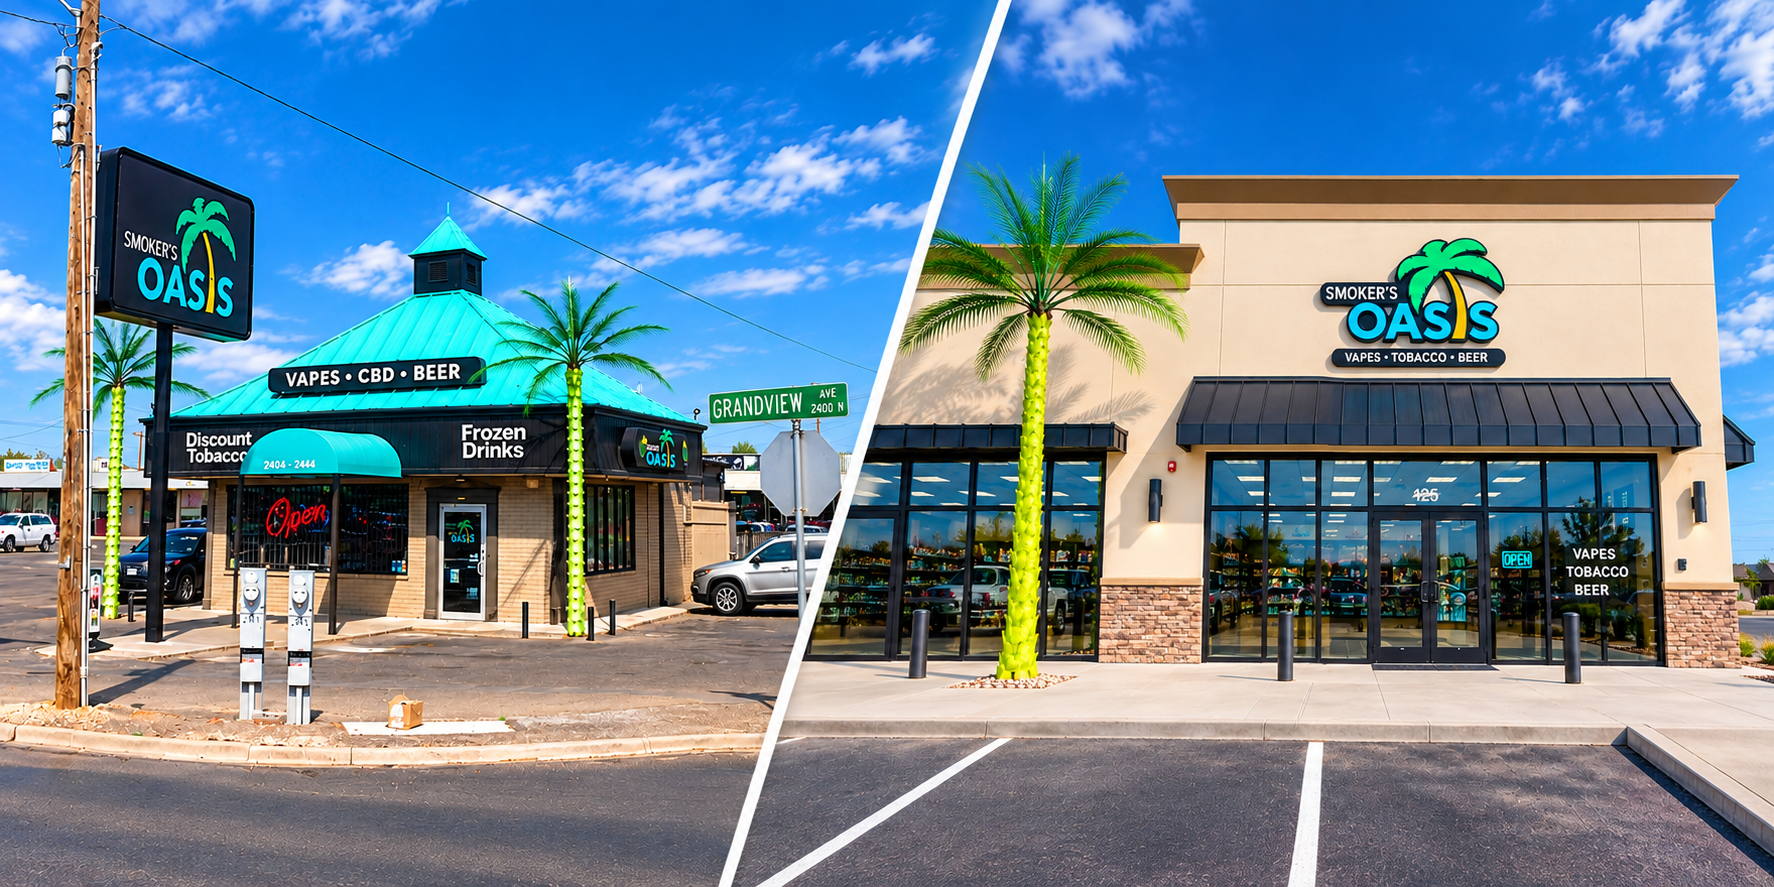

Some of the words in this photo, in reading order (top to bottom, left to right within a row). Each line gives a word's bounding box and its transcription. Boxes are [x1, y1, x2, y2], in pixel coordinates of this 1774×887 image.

[124, 230, 178, 261] SMOKER'S
[137, 257, 234, 318] OASIS
[1326, 286, 1398, 300] SMOKER'S
[1348, 301, 1500, 341] OASIS
[1345, 352, 1382, 363] VAPES
[1391, 352, 1448, 363] TOBACCO
[1458, 352, 1489, 363] BEER
[285, 370, 340, 387] VAPES
[358, 367, 395, 384] CBD
[413, 363, 461, 381] BEER
[713, 393, 803, 419] GRANDVIEW
[819, 388, 837, 399] AVE
[811, 403, 833, 414] 2400
[838, 402, 844, 412] N
[186, 431, 252, 448] Discount
[461, 424, 526, 441] Frozen
[462, 441, 524, 459] Drinks
[264, 460, 286, 470] 2404
[294, 459, 316, 469] 2444
[646, 451, 676, 468] OASIS
[266, 497, 326, 539] Open
[451, 534, 475, 543] OASIS
[1504, 553, 1530, 566] OPEN
[1572, 548, 1616, 560] VAPES
[1566, 566, 1628, 578] TOBACCO
[1575, 584, 1609, 596] BEER
